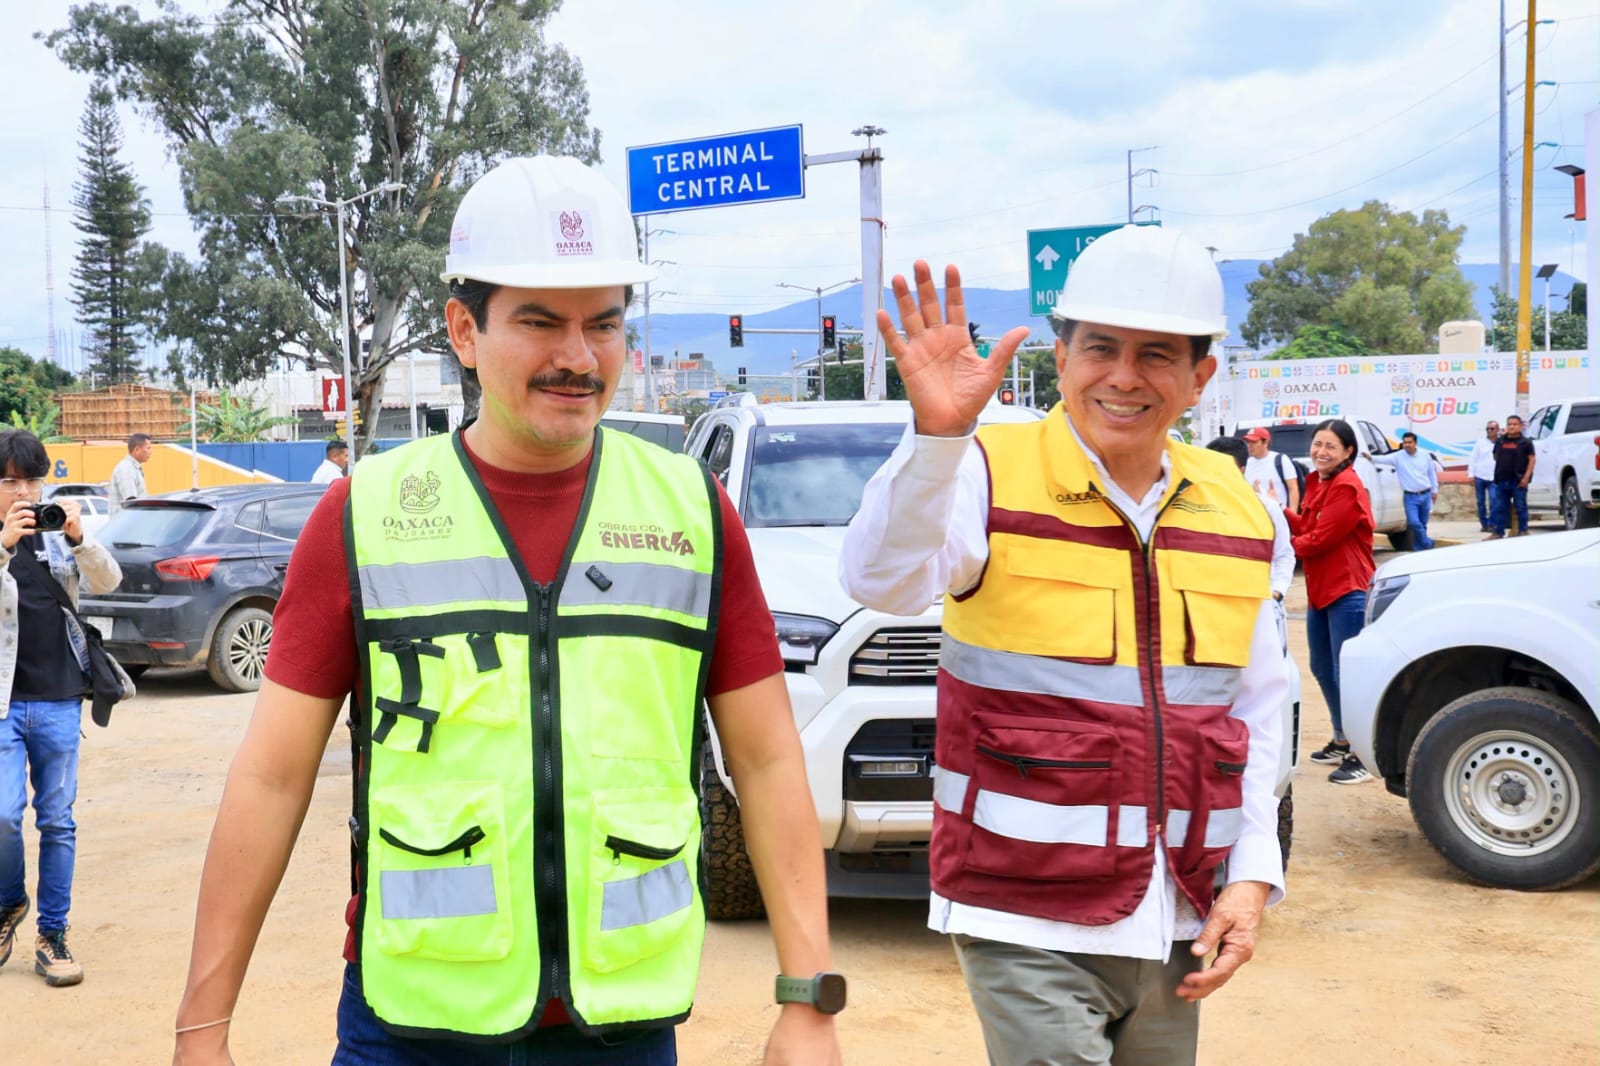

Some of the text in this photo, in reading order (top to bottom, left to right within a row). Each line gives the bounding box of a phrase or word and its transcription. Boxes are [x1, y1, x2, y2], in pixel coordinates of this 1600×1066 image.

[652, 141, 774, 175] TERMINAL
[658, 171, 770, 202] CENTRAL
[556, 241, 593, 249] OAXACA
[1283, 382, 1337, 394] OAXACA
[1415, 376, 1477, 388] OAXACA
[1262, 400, 1341, 418] BinniBus
[1389, 397, 1480, 417] BinniBus
[383, 515, 454, 531] OAXACA
[598, 521, 664, 533] OBRAS CON
